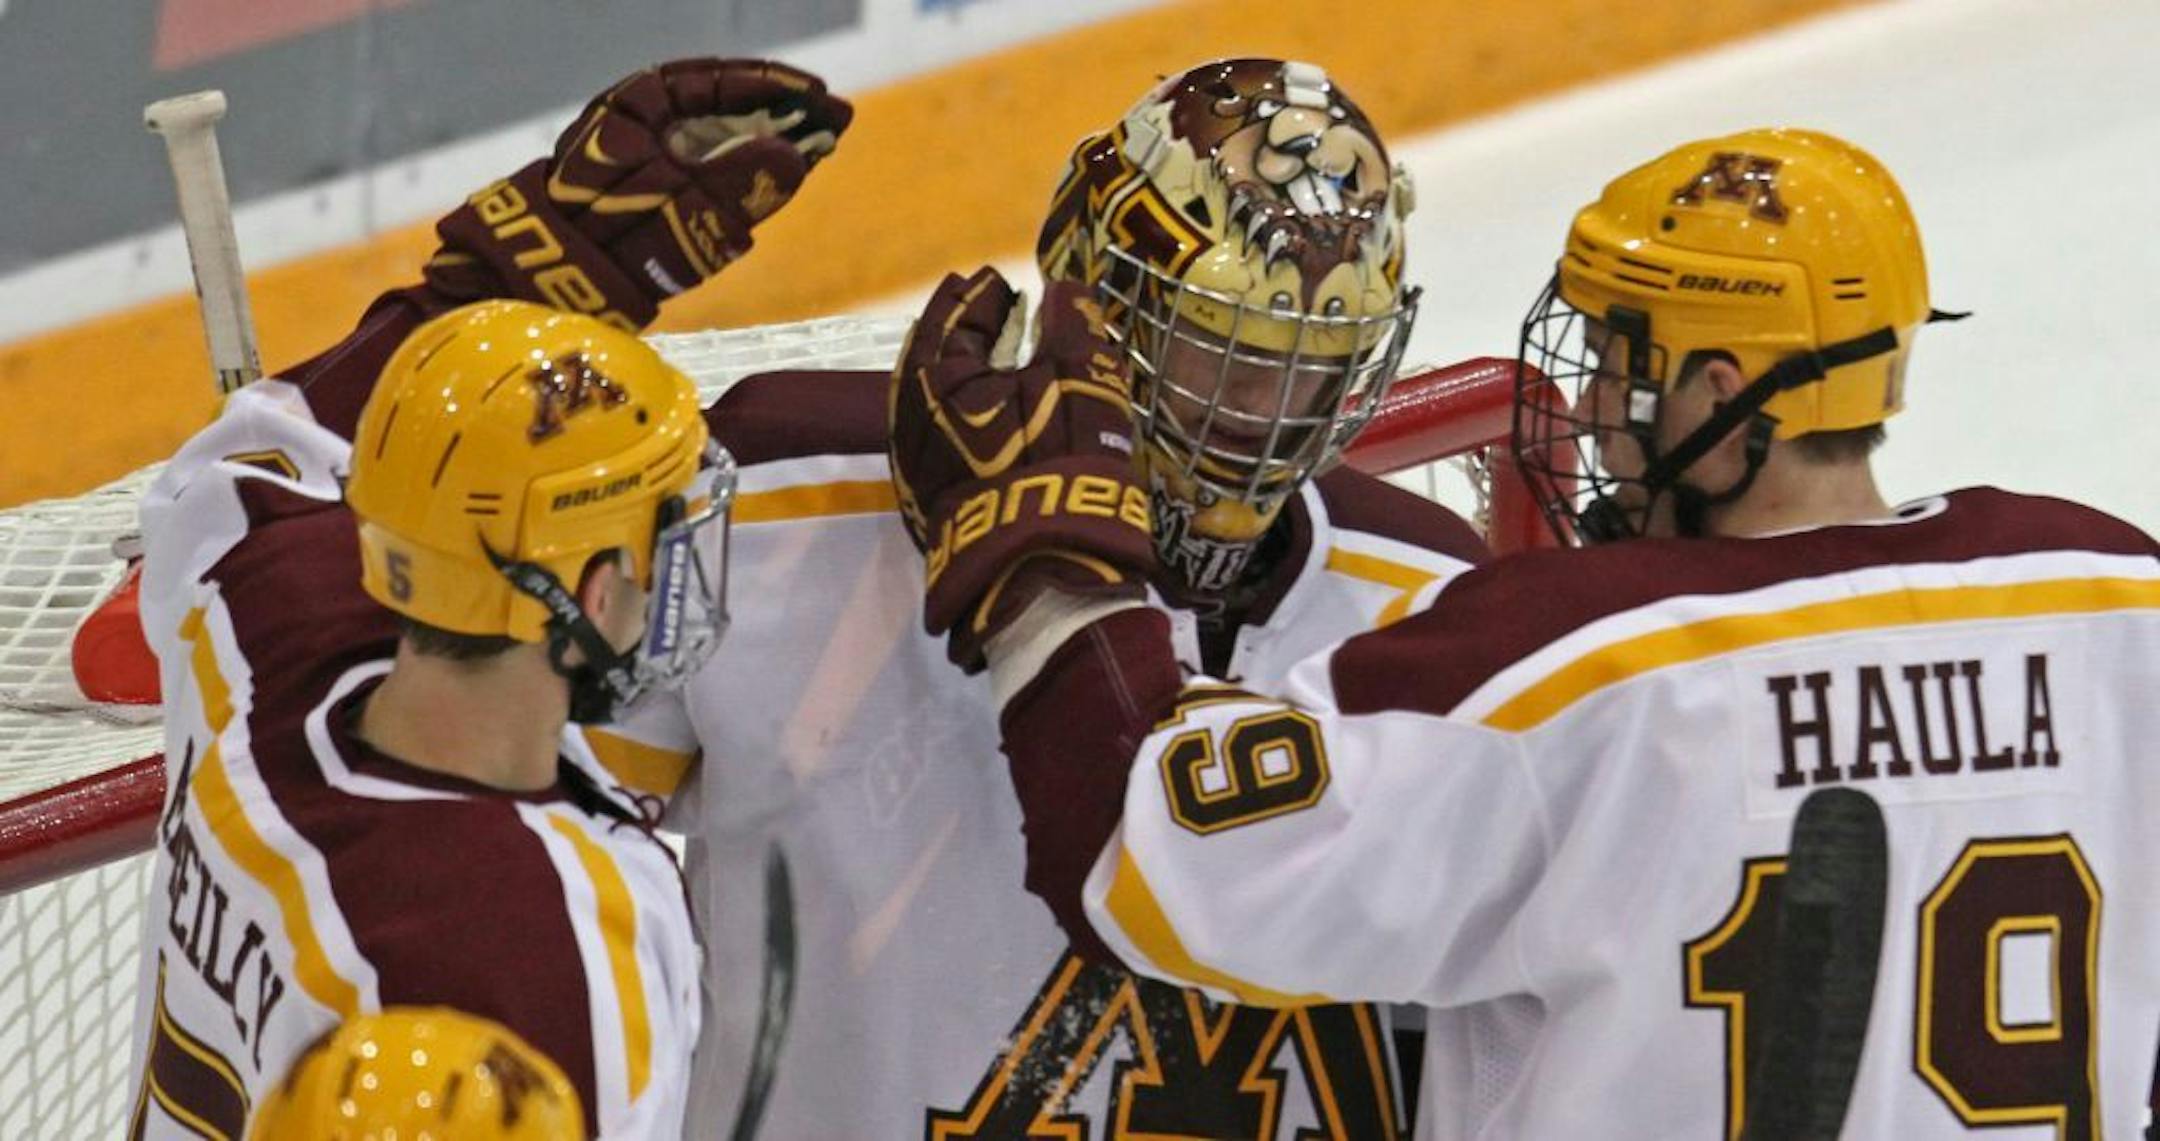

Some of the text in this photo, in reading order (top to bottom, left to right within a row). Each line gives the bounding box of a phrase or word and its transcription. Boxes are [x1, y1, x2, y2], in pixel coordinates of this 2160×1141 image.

[386, 548, 413, 604] 5
[1155, 682, 1332, 837] 9
[1766, 654, 2060, 789] HAULA
